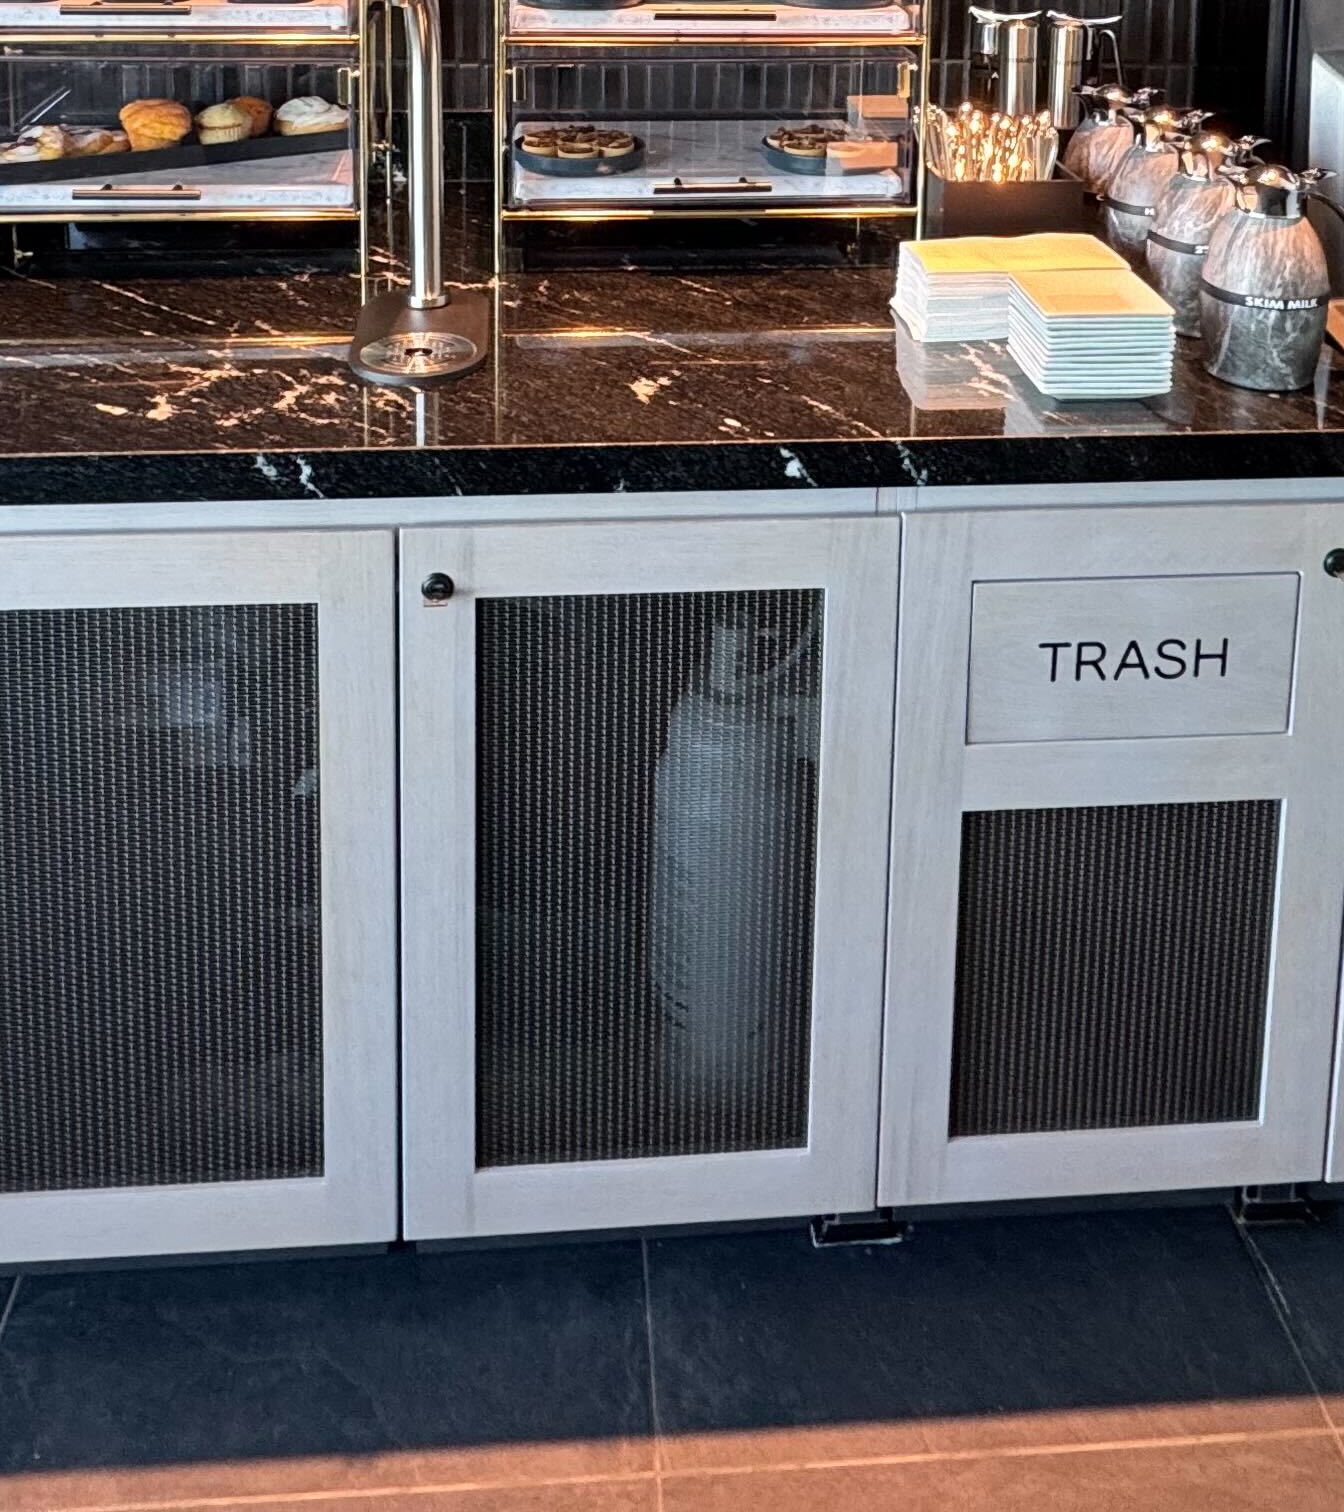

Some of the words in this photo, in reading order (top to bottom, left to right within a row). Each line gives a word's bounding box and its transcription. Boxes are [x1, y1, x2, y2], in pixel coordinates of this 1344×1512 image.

[1244, 296, 1285, 310] SKIM
[1287, 298, 1318, 310] MILK
[1038, 637, 1229, 682] TRASH
